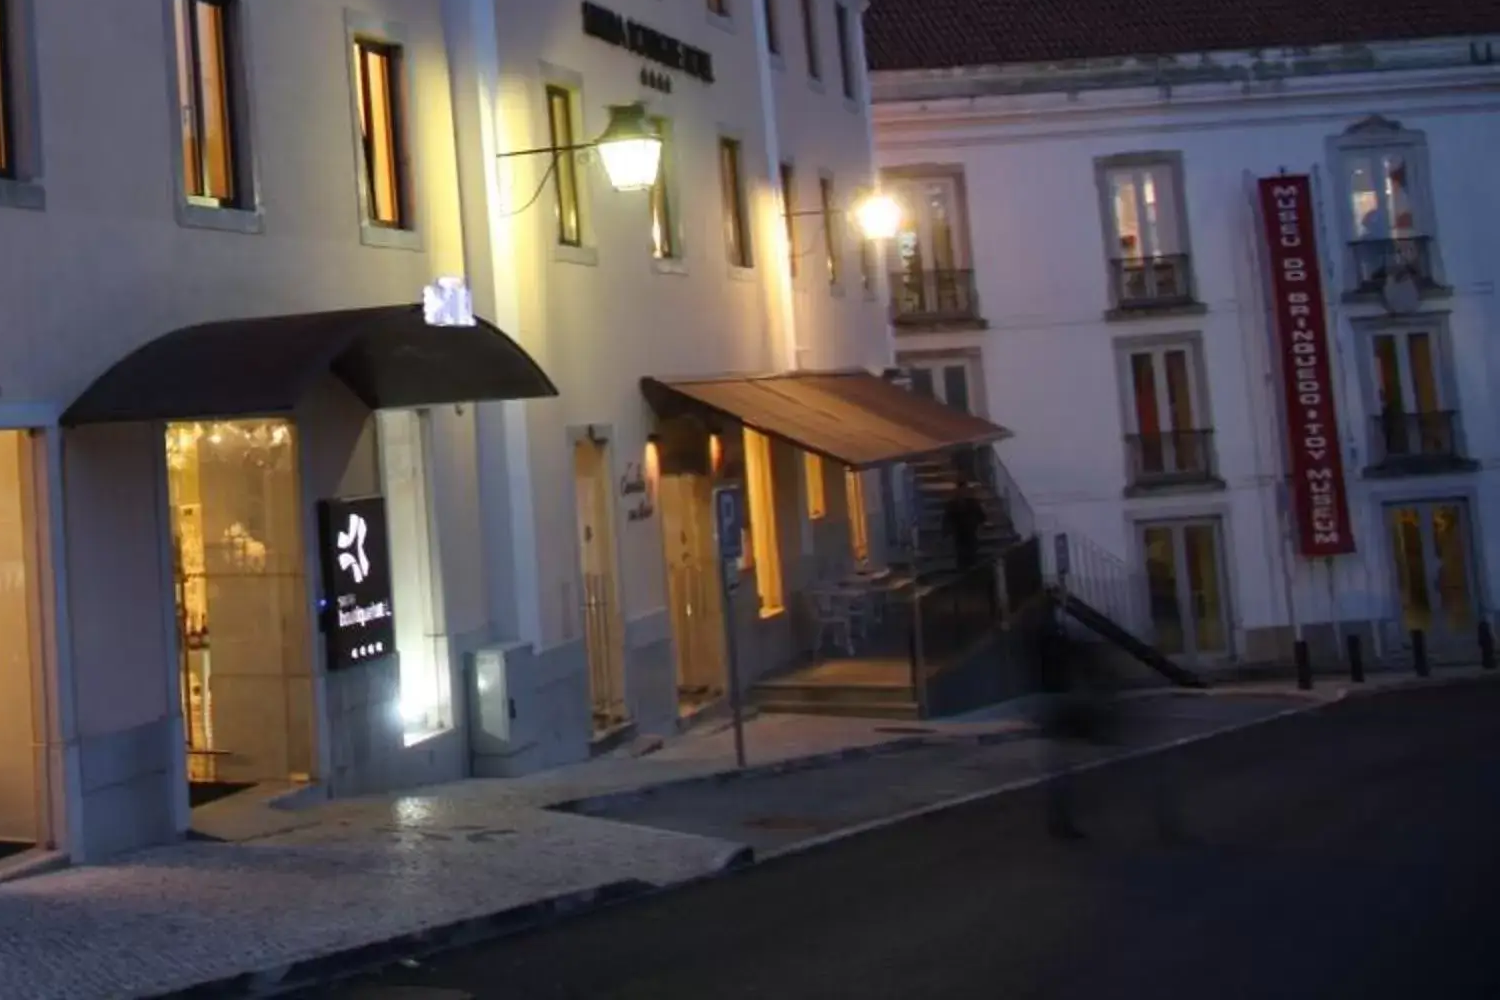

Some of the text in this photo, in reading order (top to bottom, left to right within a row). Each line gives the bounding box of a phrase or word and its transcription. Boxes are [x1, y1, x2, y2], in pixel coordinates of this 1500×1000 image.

[1272, 184, 1301, 247] MUSEU
[1283, 257, 1308, 282] DO
[1303, 422, 1328, 461] TOY
[1305, 467, 1340, 545] MUSEUM
